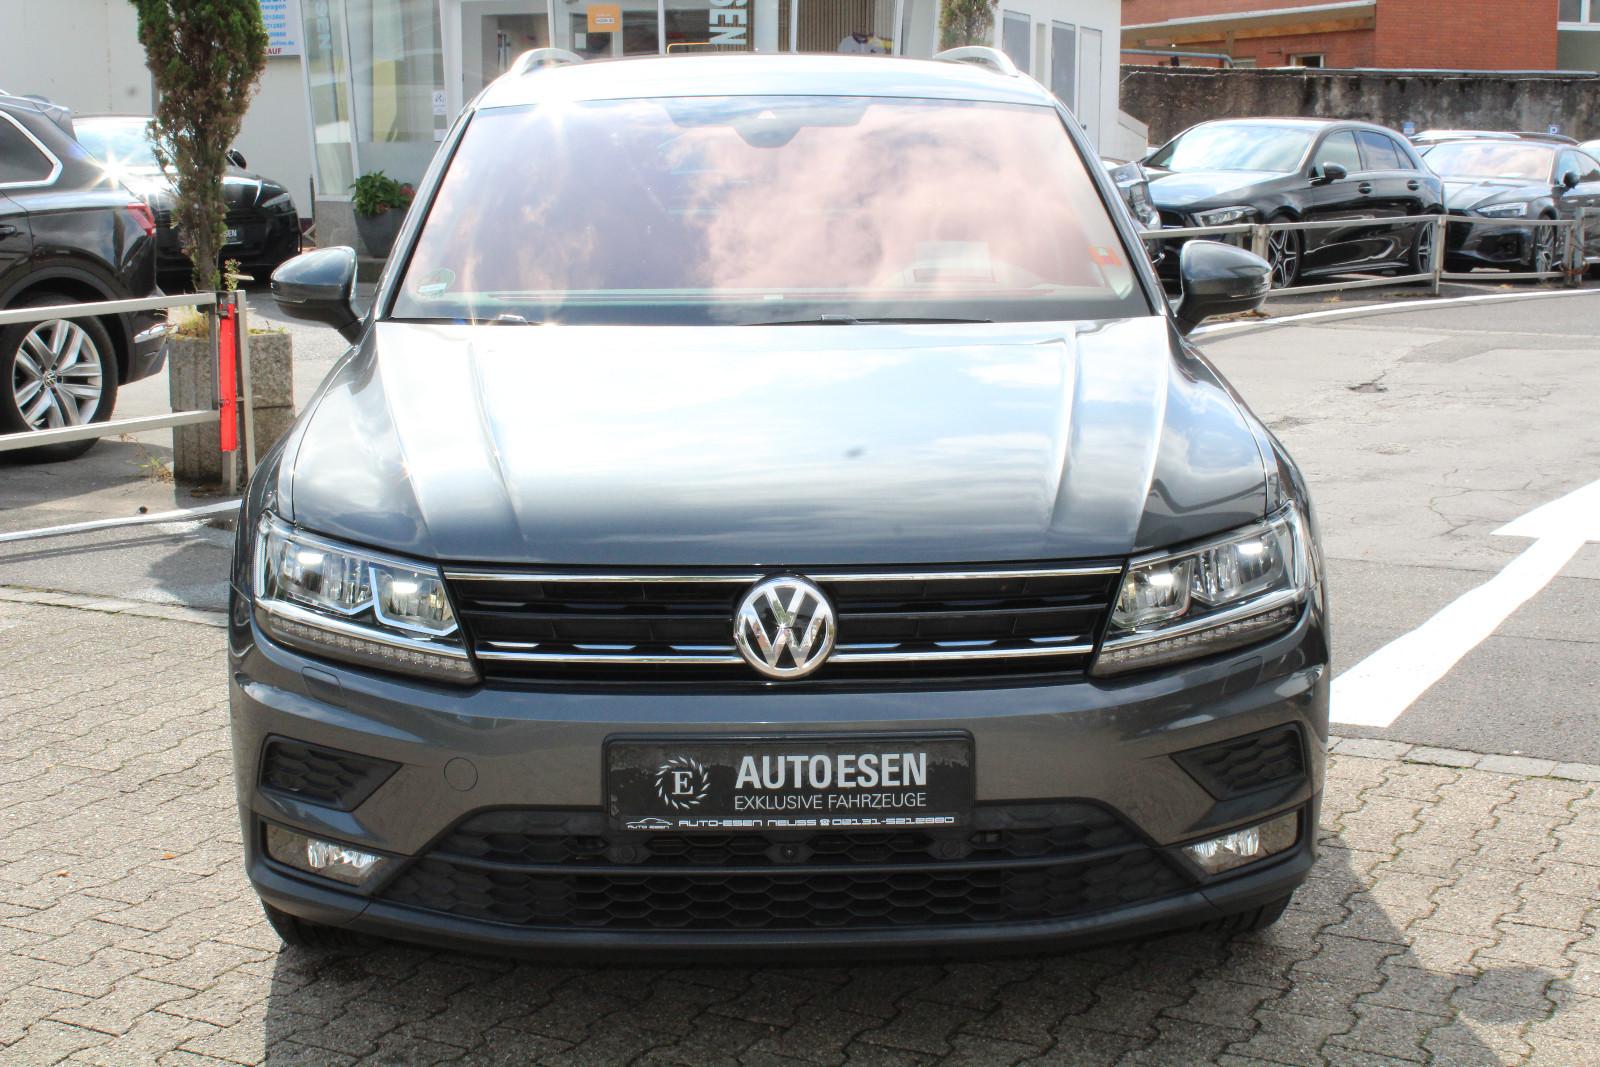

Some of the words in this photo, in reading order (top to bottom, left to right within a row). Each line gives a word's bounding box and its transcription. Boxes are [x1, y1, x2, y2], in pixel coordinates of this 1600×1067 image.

[735, 753, 927, 789] AUTOESEN
[671, 771, 694, 795] E
[734, 795, 823, 810] EXKLUSIVE
[828, 792, 927, 809] FAHRZEUGE
[678, 819, 763, 828] AUTO-ESEN
[767, 818, 817, 827] NEUSS
